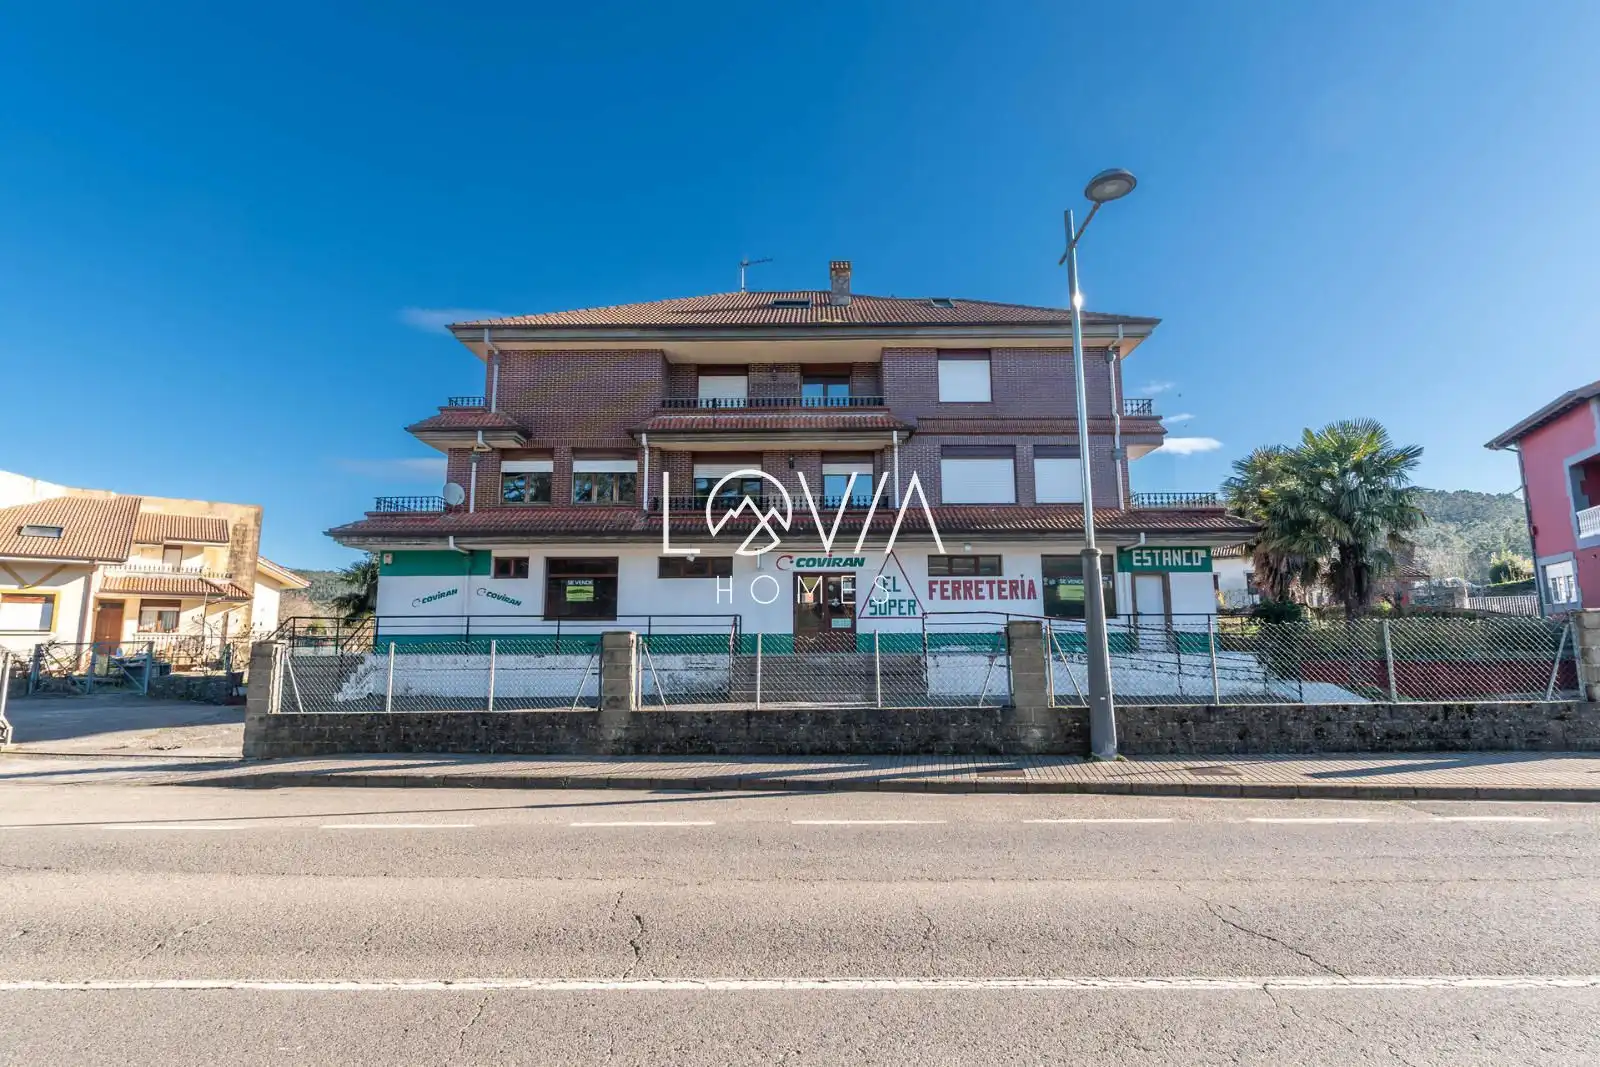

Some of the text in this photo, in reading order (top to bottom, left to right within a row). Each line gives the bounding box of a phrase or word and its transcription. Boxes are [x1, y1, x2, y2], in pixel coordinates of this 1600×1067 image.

[1132, 549, 1202, 566] ESTANCO
[883, 576, 901, 593] EL
[868, 599, 917, 616] SUPER
